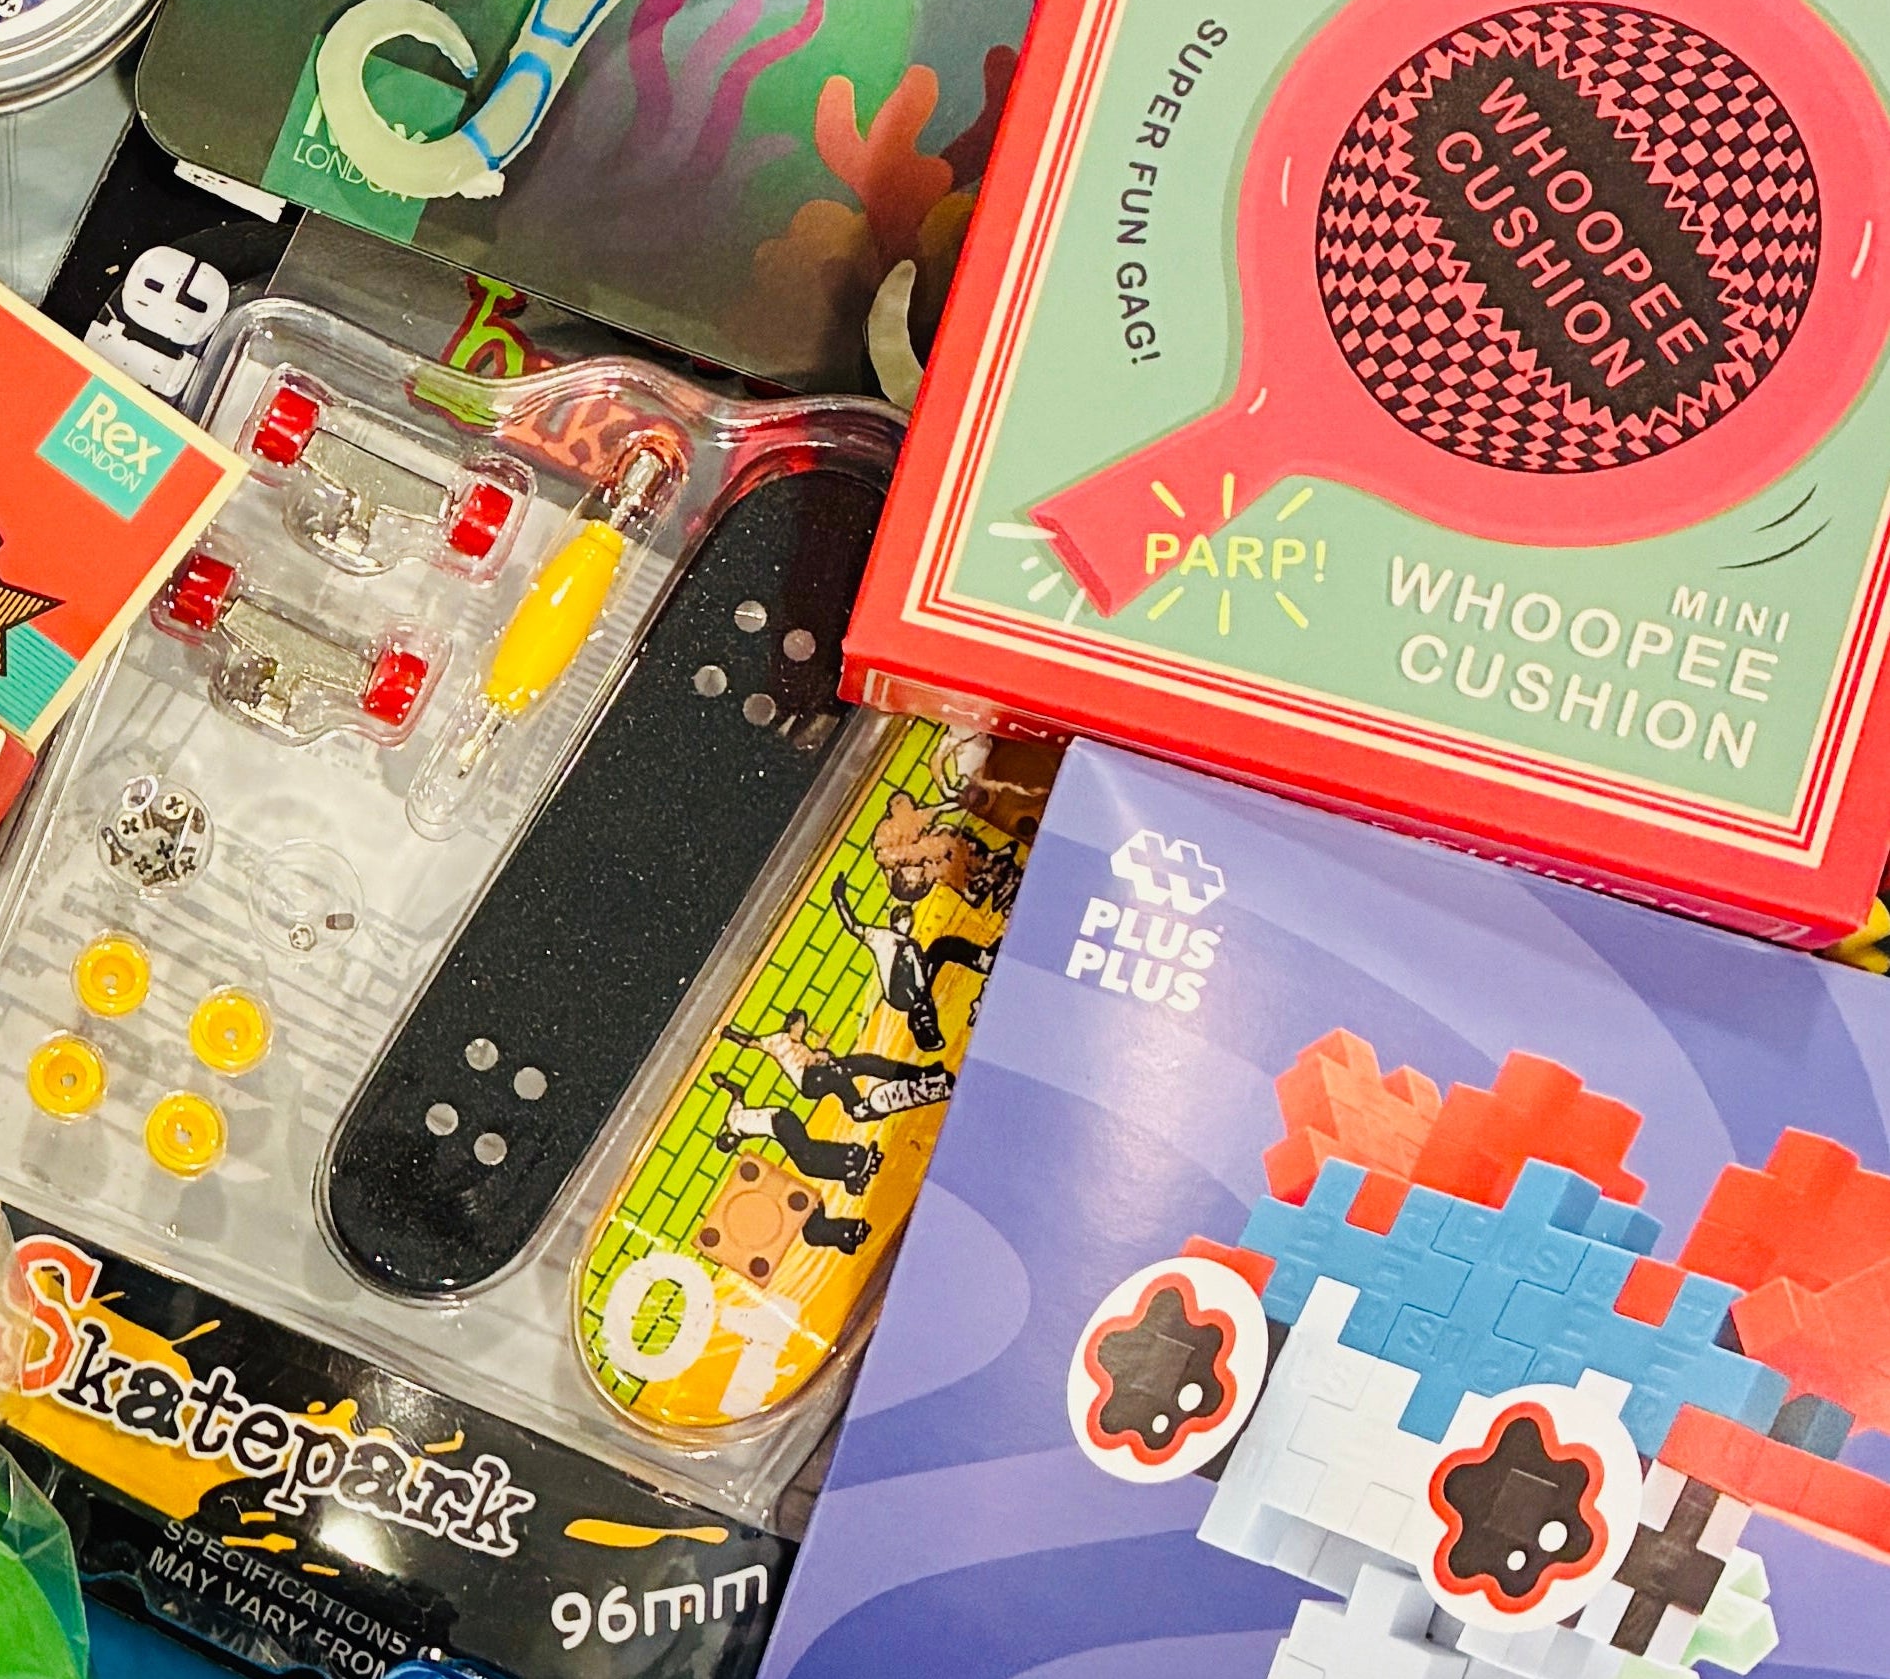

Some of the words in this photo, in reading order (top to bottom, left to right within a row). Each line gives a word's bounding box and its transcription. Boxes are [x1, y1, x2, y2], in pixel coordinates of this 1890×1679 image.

[1135, 17, 1229, 152] SUPER
[1119, 161, 1166, 246] FUN
[1480, 77, 1709, 370] WHOOPEE
[1434, 128, 1650, 389] CUSHION
[1114, 259, 1163, 365] GAG!
[62, 425, 144, 497] LONDON
[74, 388, 165, 478] Rex
[1145, 531, 1328, 583] PARP!
[1390, 555, 1779, 702] WHOOPEE
[1672, 585, 1793, 645] MINI
[1400, 633, 1759, 769] CUSHION
[1066, 940, 1206, 1012] PLUS
[1079, 897, 1222, 968] PLUS
[601, 1250, 802, 1417] 01
[148, 1546, 218, 1595] MAY
[223, 1581, 309, 1643] VARY
[163, 1519, 412, 1657] SPECIFICATIONS
[551, 1563, 769, 1651] 96mm
